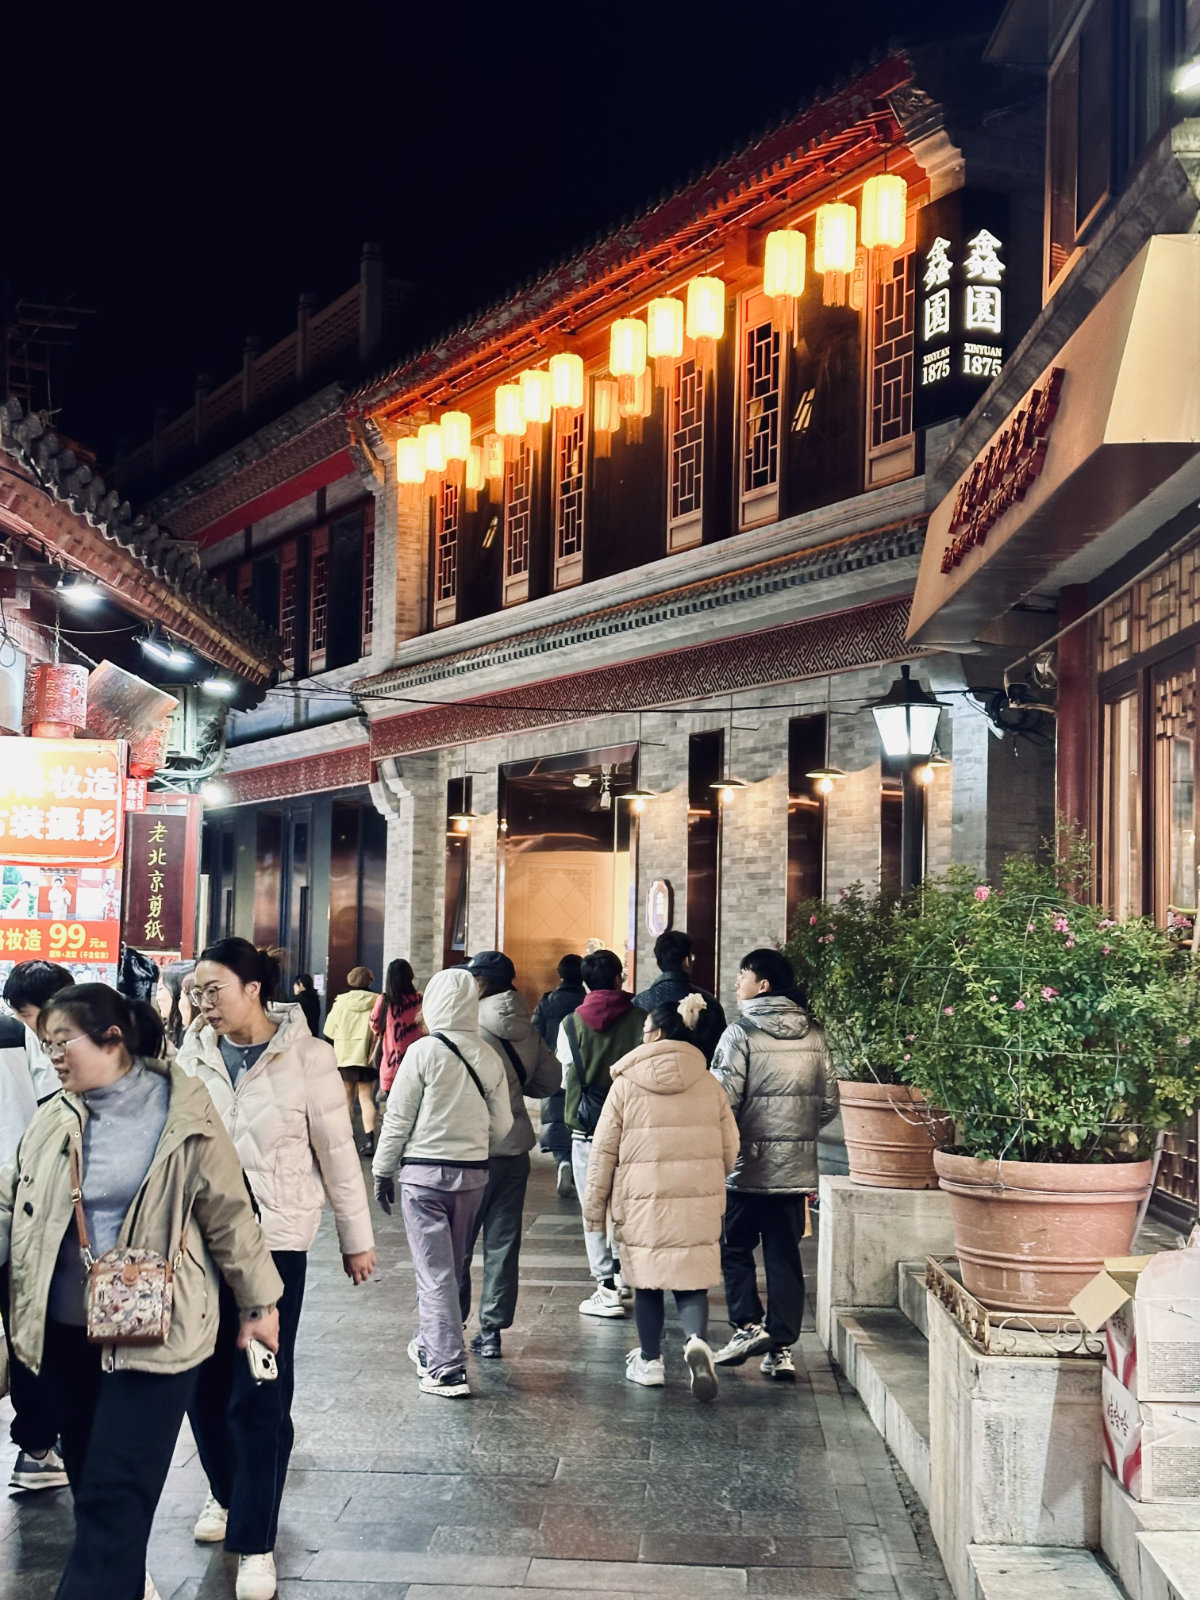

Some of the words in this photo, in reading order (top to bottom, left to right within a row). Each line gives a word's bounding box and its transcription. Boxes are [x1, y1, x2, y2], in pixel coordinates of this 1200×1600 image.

[964, 342, 1003, 357] XINYUAN
[921, 358, 951, 385] 1875
[963, 354, 1002, 377] 1875
[143, 820, 168, 942] 老北京剪纸
[49, 922, 86, 950] 99
